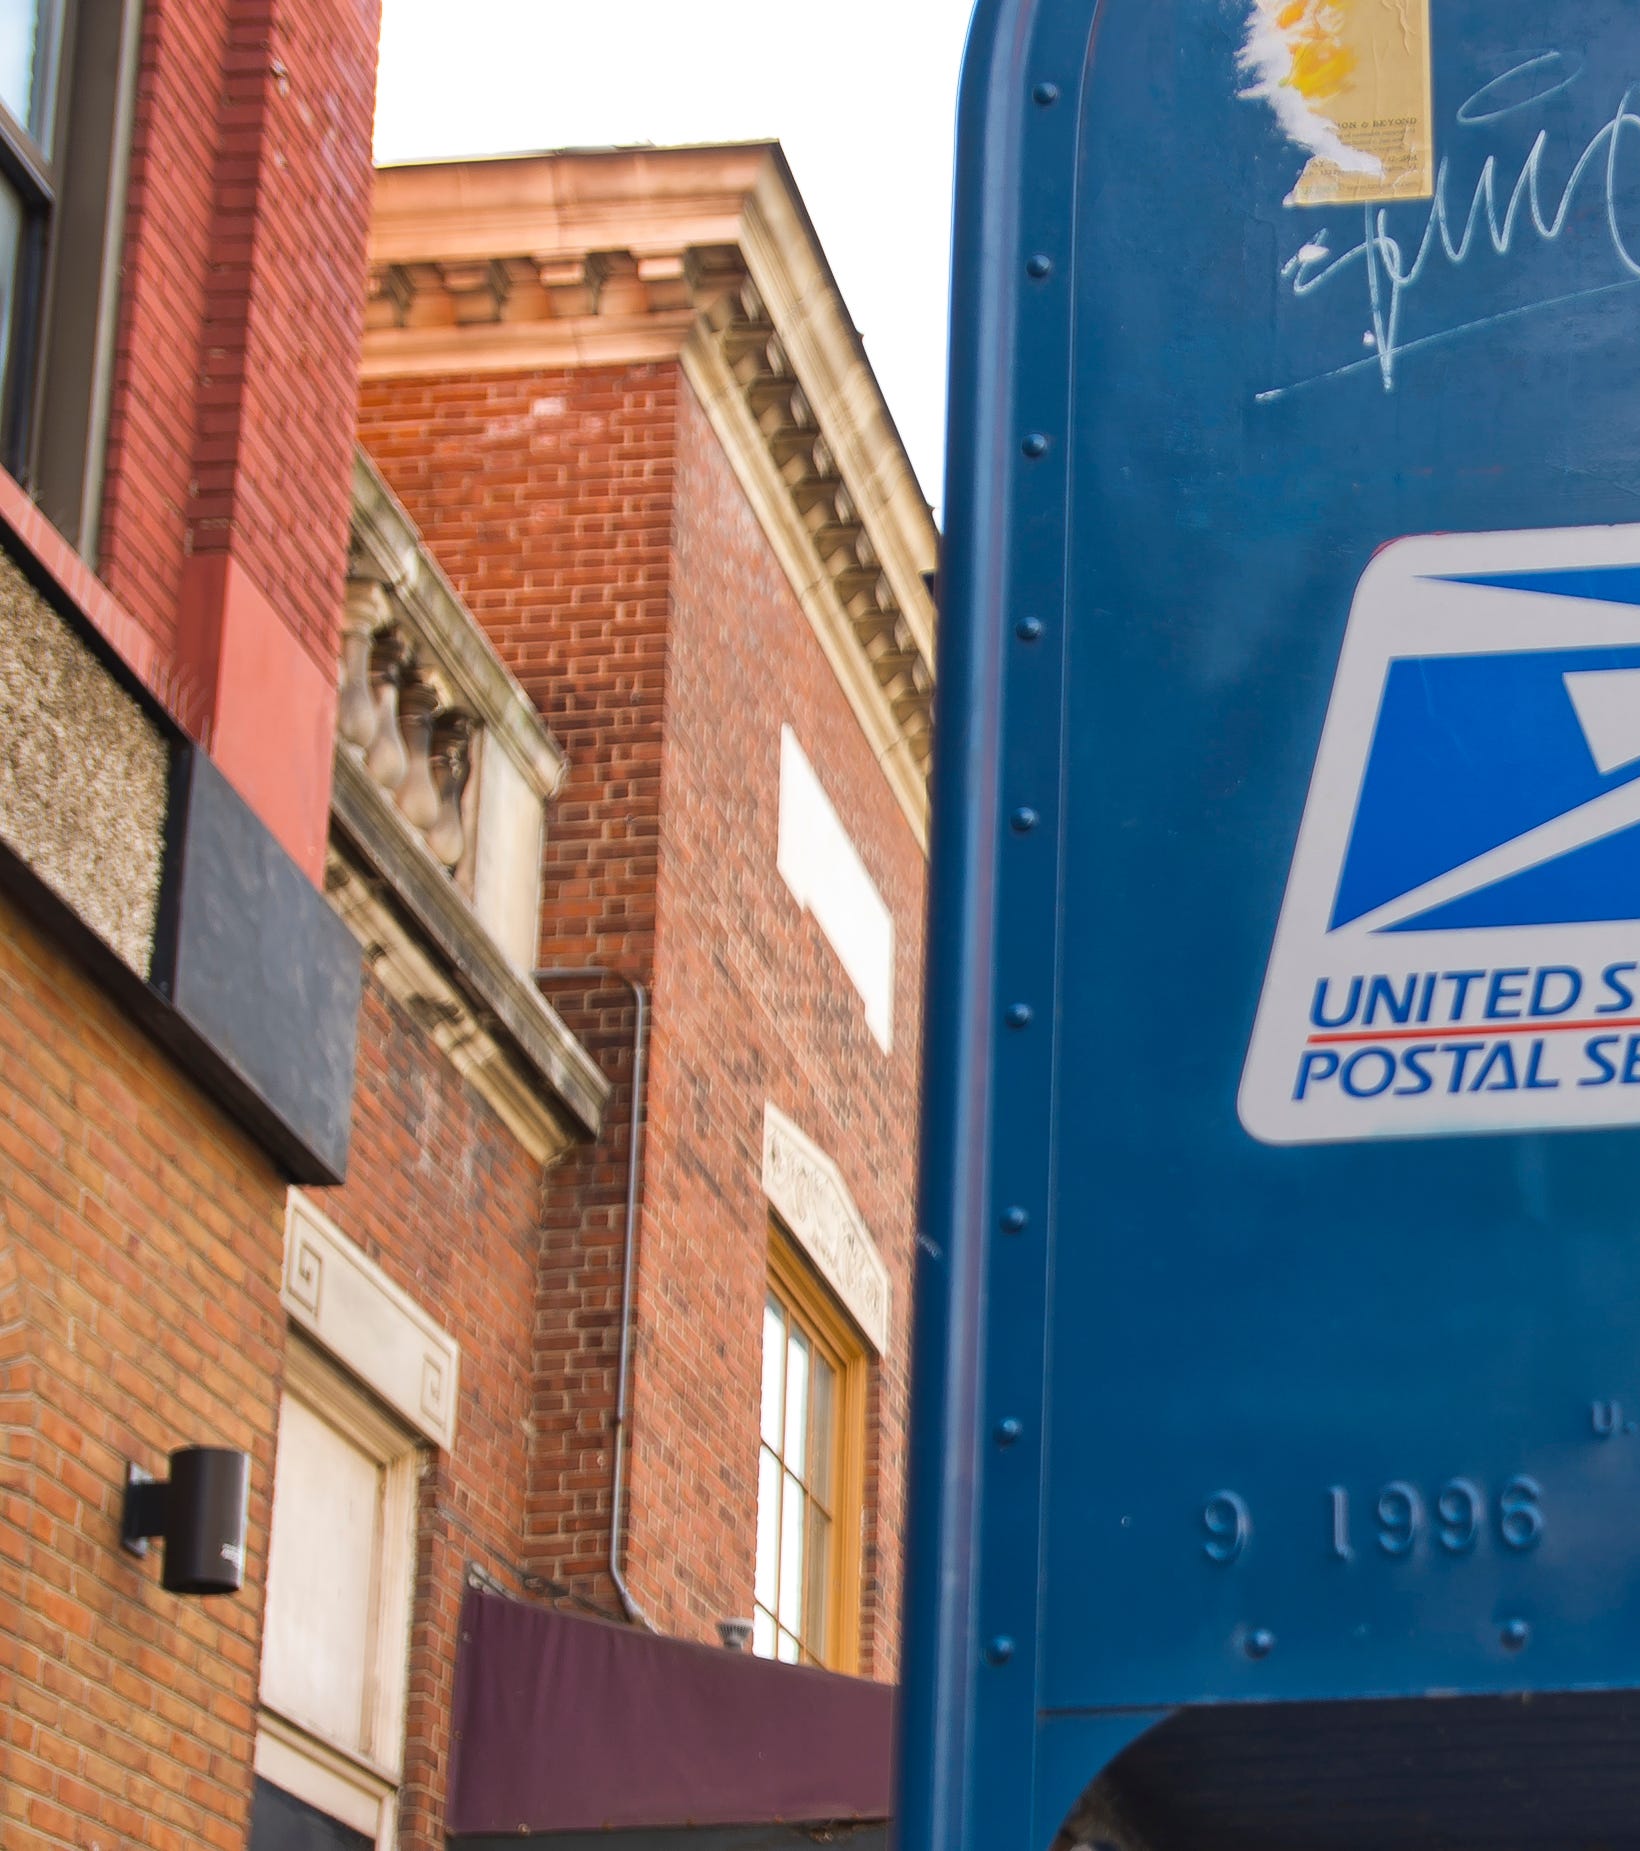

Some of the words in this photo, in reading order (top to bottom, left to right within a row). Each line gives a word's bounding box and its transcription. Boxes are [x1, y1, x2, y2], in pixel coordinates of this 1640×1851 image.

[1373, 117, 1417, 128] BEYOND
[1308, 964, 1583, 1027] UNITED
[1291, 1038, 1560, 1102] POSTAL
[1202, 1488, 1252, 1562] 9
[1328, 1473, 1545, 1562] 1996
